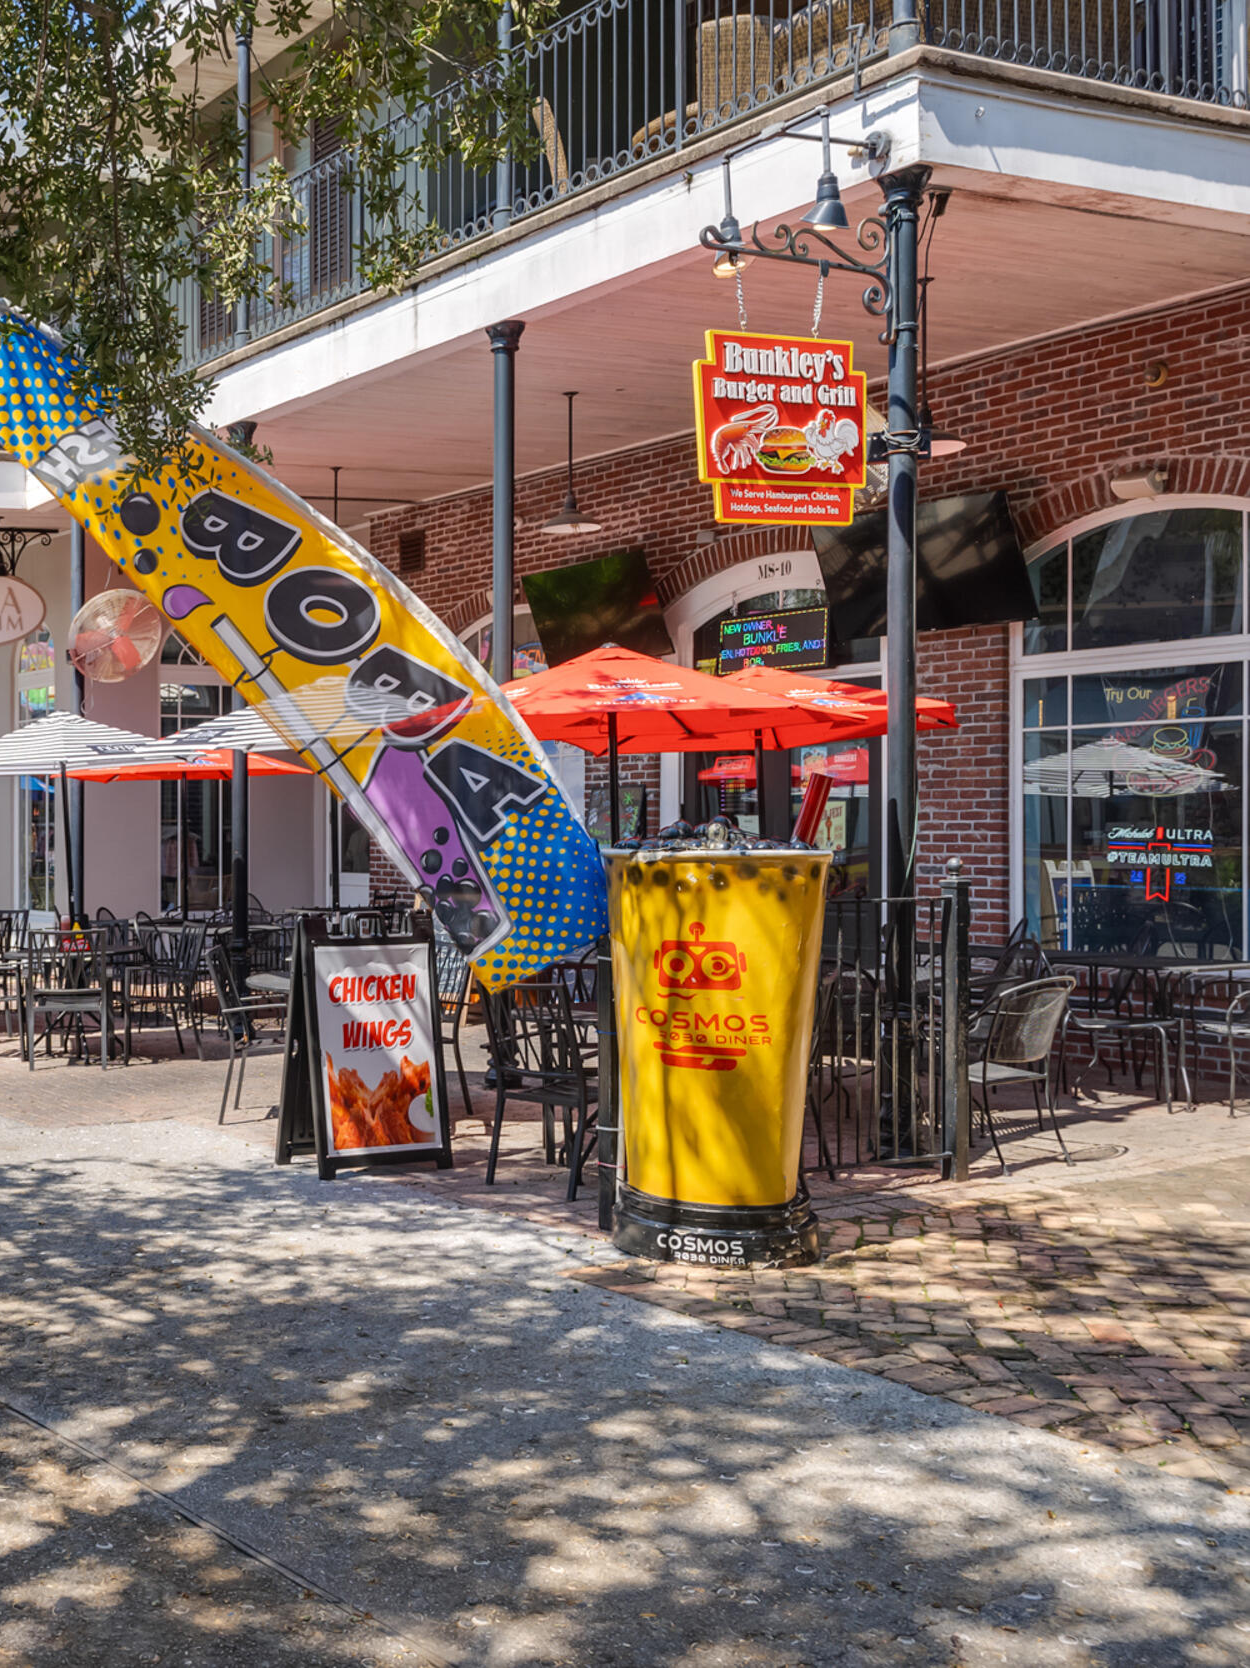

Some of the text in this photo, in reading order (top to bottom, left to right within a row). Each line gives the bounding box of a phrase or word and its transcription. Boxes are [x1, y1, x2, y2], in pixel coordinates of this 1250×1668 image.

[723, 341, 845, 383] Bunkley's
[713, 377, 857, 407] Burger and Grill
[730, 488, 841, 502] We Serve Hamburgers, Chicken,
[764, 503, 793, 514] Seafood
[794, 504, 807, 514] and
[808, 504, 826, 515] Boba
[827, 505, 839, 515] Tea
[758, 561, 792, 580] MS-10
[723, 623, 742, 635] NEW
[1105, 687, 1153, 704] Try Our
[1102, 676, 1210, 746] AMBURGERS
[1107, 827, 1213, 841] Michelob ULTRA
[1107, 851, 1213, 868] #TEAMULTRA
[328, 973, 417, 1004] CHICKEN
[635, 1006, 770, 1033] COSMOS
[342, 1018, 412, 1050] WINGS
[715, 1034, 773, 1046] DINER
[656, 1233, 745, 1256] COSMOS
[709, 1255, 746, 1266] DINER
